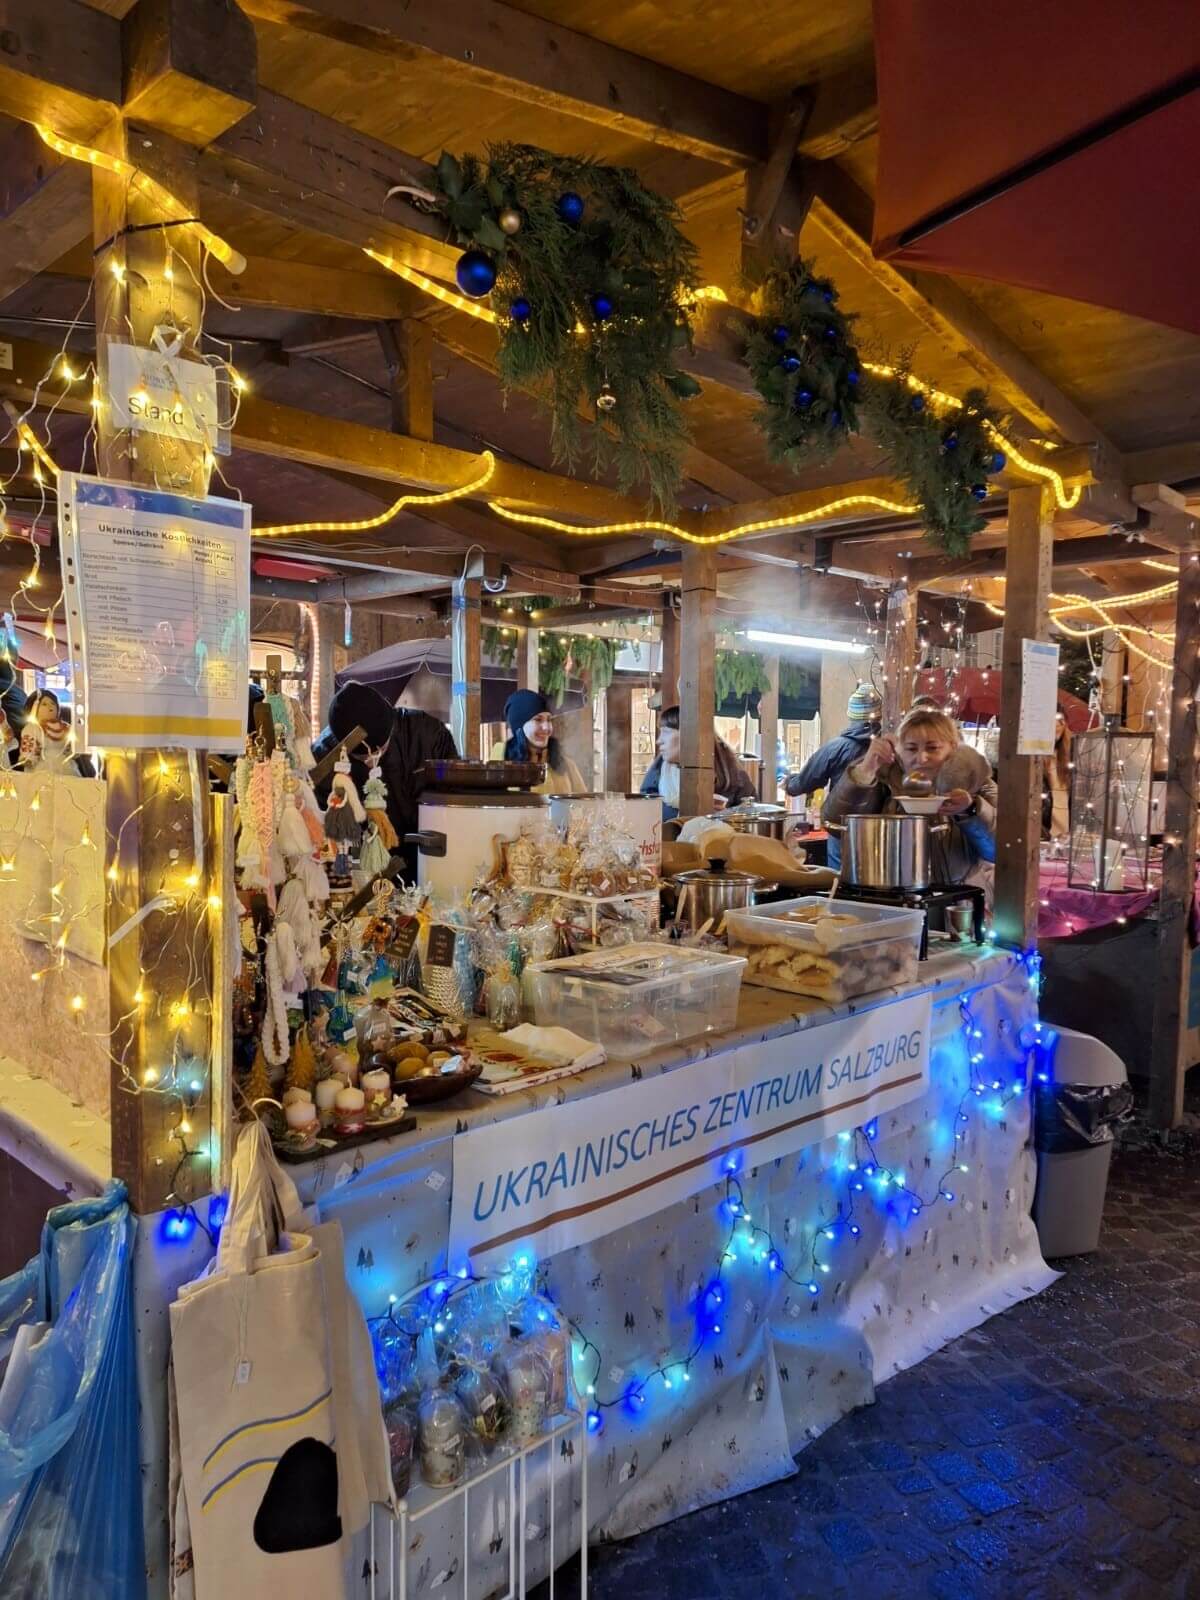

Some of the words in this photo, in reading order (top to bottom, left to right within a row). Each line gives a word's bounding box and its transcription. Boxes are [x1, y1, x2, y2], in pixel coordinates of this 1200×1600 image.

[98, 524, 159, 538] Ukrainische
[473, 1107, 700, 1222] UKRAINISCHES
[703, 1064, 823, 1134] ZENTRUM
[827, 1031, 921, 1090] SALZBURG
